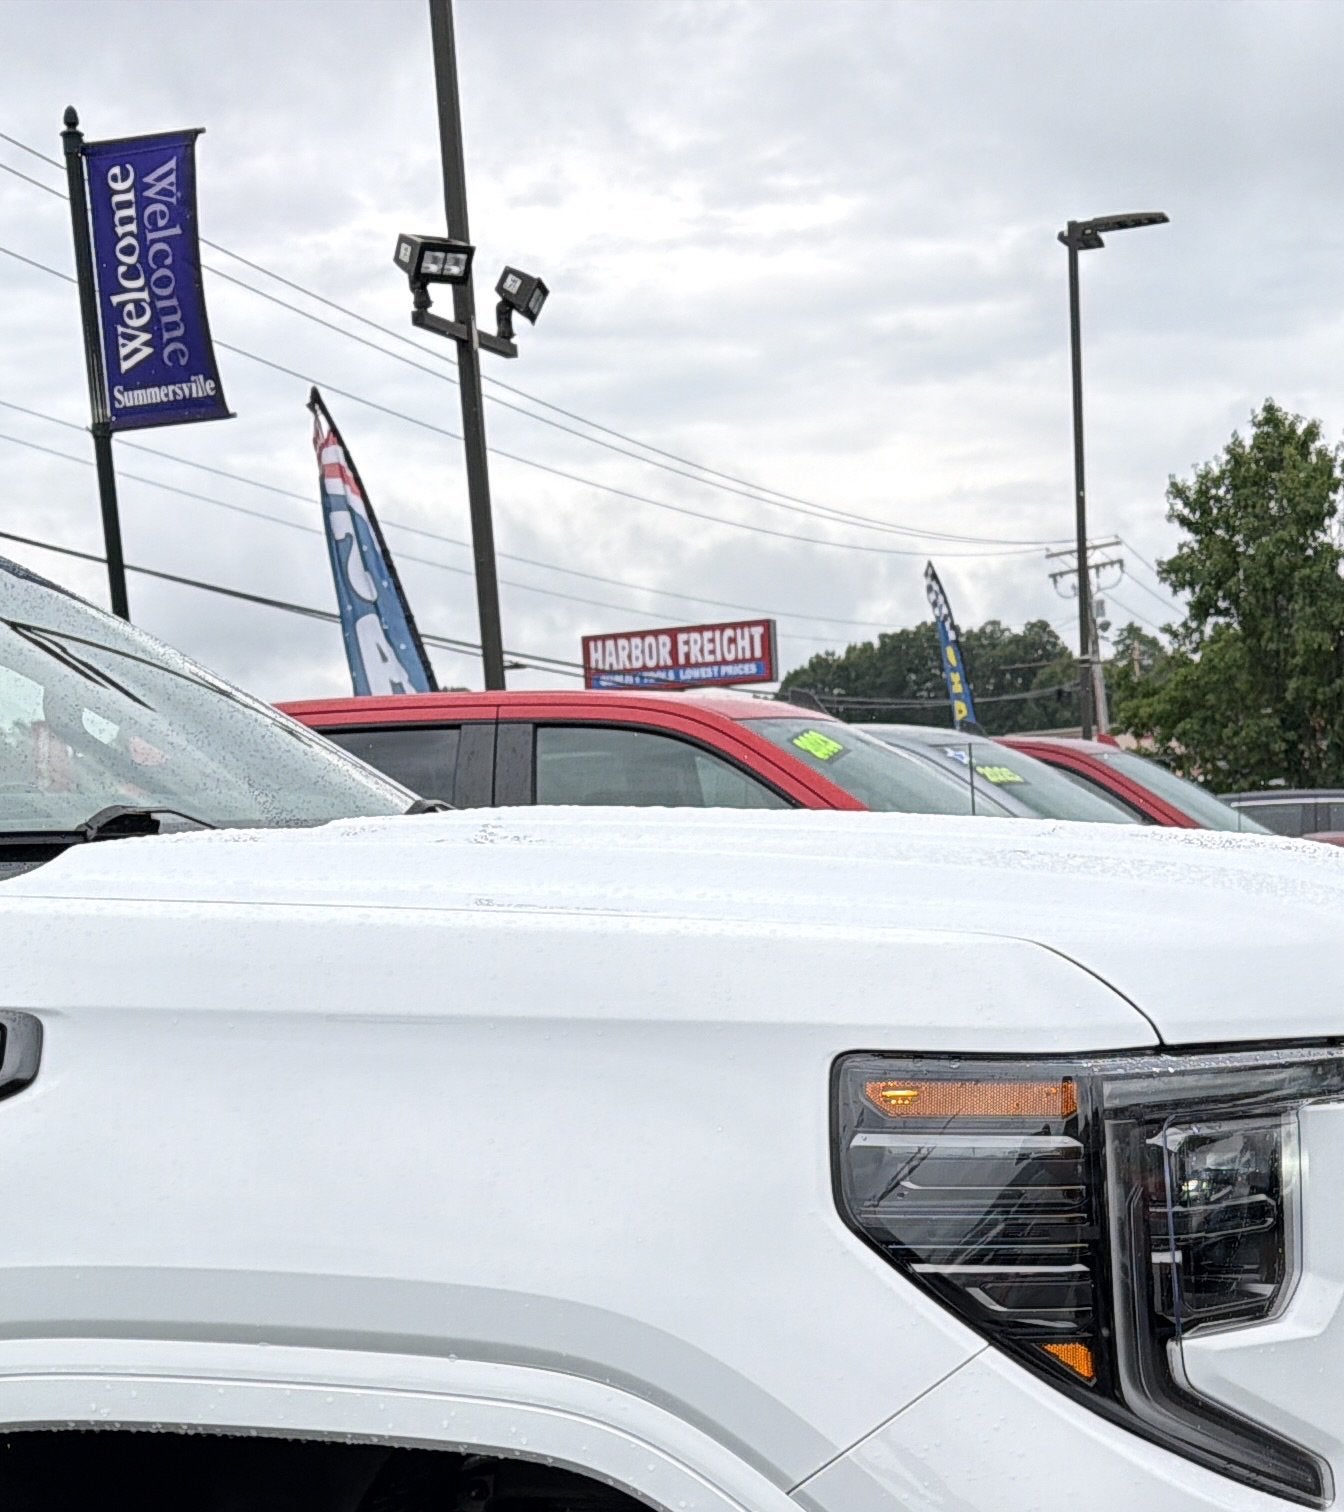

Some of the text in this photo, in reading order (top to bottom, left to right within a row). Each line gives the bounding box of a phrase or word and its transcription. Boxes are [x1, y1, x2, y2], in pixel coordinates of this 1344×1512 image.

[107, 162, 155, 374] Welcome
[142, 155, 190, 368] Welcome
[113, 373, 217, 409] Summersville
[588, 625, 765, 671] HARBOR FREIGHT
